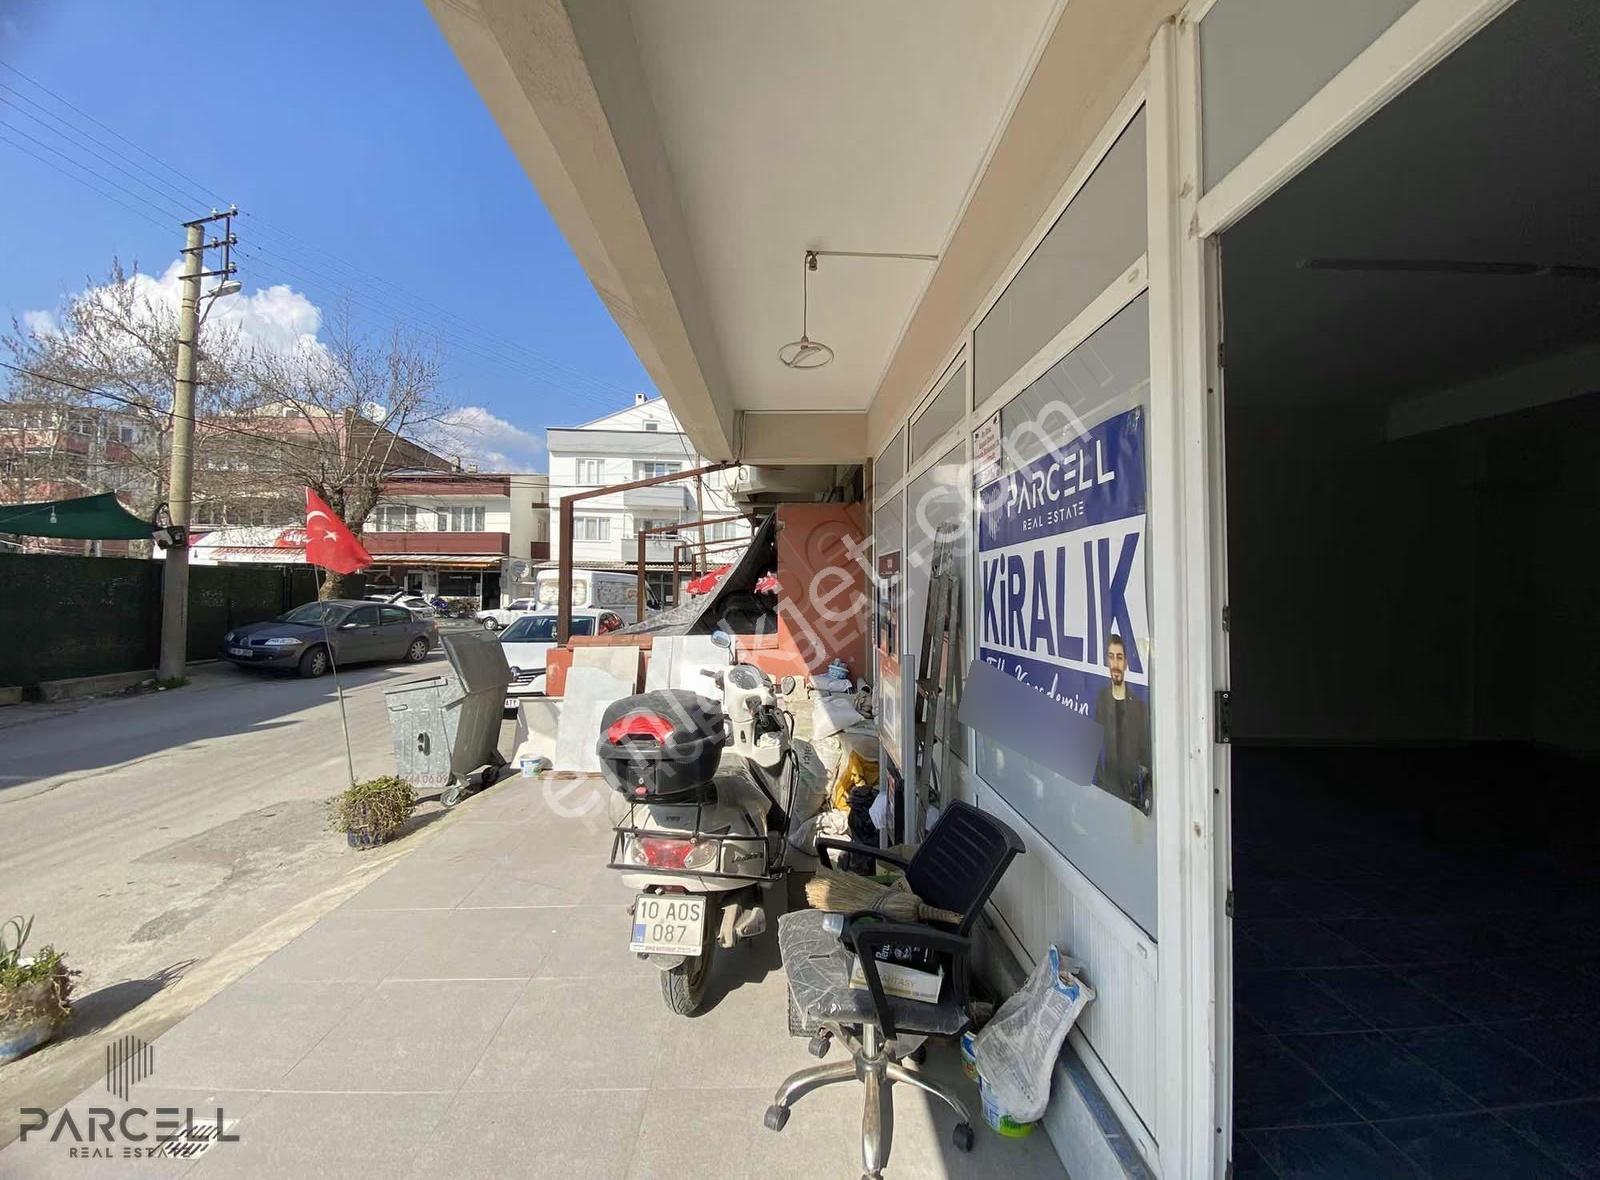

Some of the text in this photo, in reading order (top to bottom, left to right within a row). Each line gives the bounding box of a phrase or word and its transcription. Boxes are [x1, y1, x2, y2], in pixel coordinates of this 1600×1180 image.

[1007, 440, 1116, 519] PARCELL
[1023, 501, 1085, 531] REAL ESTATE
[641, 902, 701, 923] 10 AOS
[652, 925, 687, 944] 087
